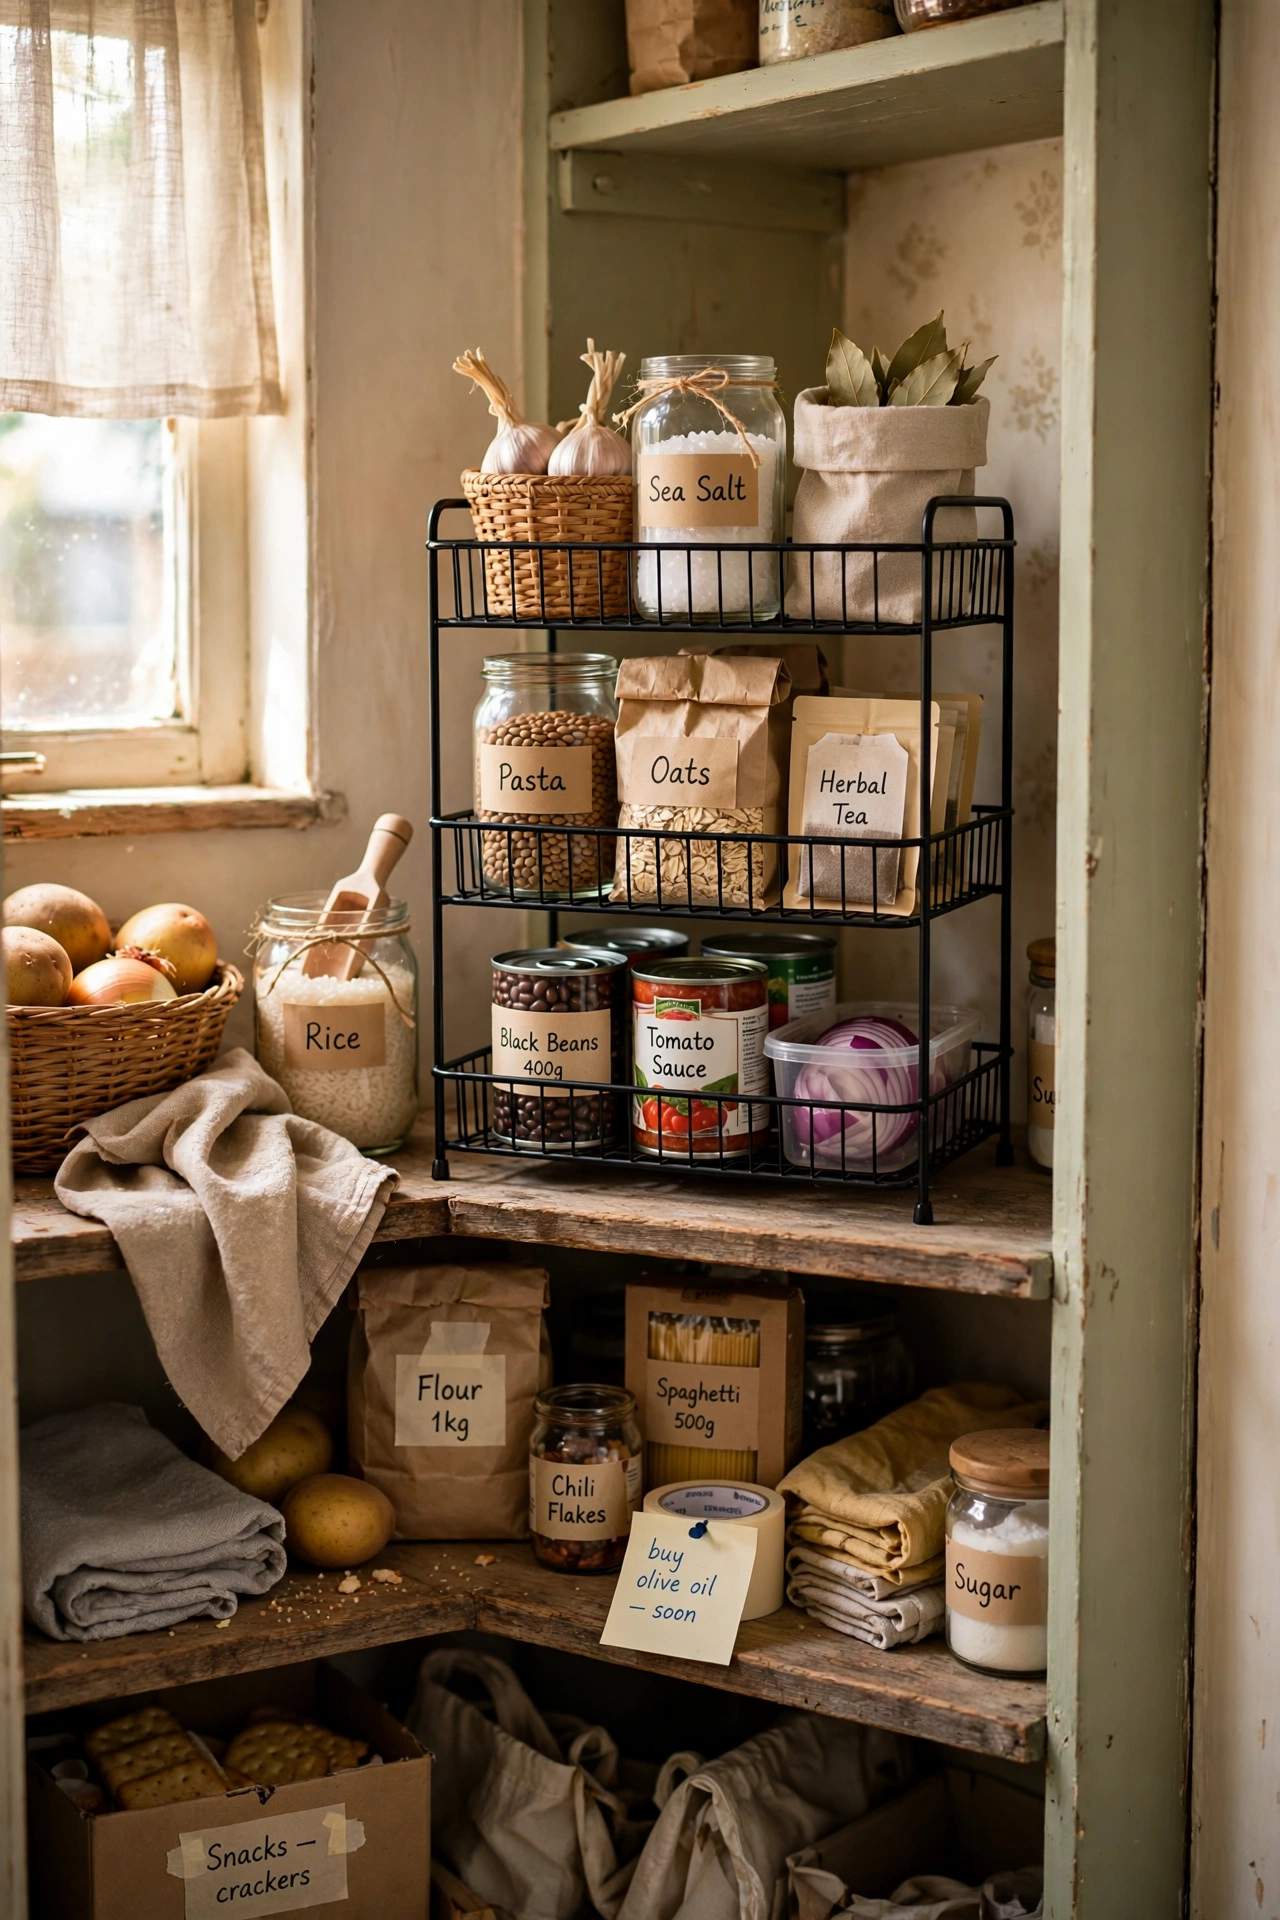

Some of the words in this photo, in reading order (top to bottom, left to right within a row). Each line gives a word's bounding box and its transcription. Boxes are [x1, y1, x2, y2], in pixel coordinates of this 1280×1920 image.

[649, 475, 686, 502] Sea
[696, 473, 747, 502] Salt
[499, 762, 567, 792] Pasta
[651, 755, 711, 786] Oats
[820, 769, 887, 795] Herbal
[832, 803, 869, 825] Tea
[306, 1021, 361, 1051] Rice
[500, 1027, 540, 1052] Black
[547, 1032, 599, 1053] Beans
[646, 1025, 715, 1051] Tomato
[523, 1060, 563, 1080] 400g
[652, 1054, 707, 1078] Sauce
[1032, 1075, 1055, 1114] Su
[418, 1373, 483, 1401] Flour
[656, 1376, 741, 1409] Spaghetti
[431, 1410, 469, 1442] 1kg
[674, 1412, 715, 1438] 500g
[551, 1474, 595, 1497] Chili
[548, 1501, 607, 1524] Flakes
[647, 1537, 684, 1573] buy
[636, 1571, 680, 1593] olive
[690, 1574, 718, 1596] oil
[954, 1562, 1022, 1608] Sugar
[652, 1605, 696, 1623] soon
[206, 1834, 288, 1871] Snacks
[216, 1869, 310, 1903] crackers
